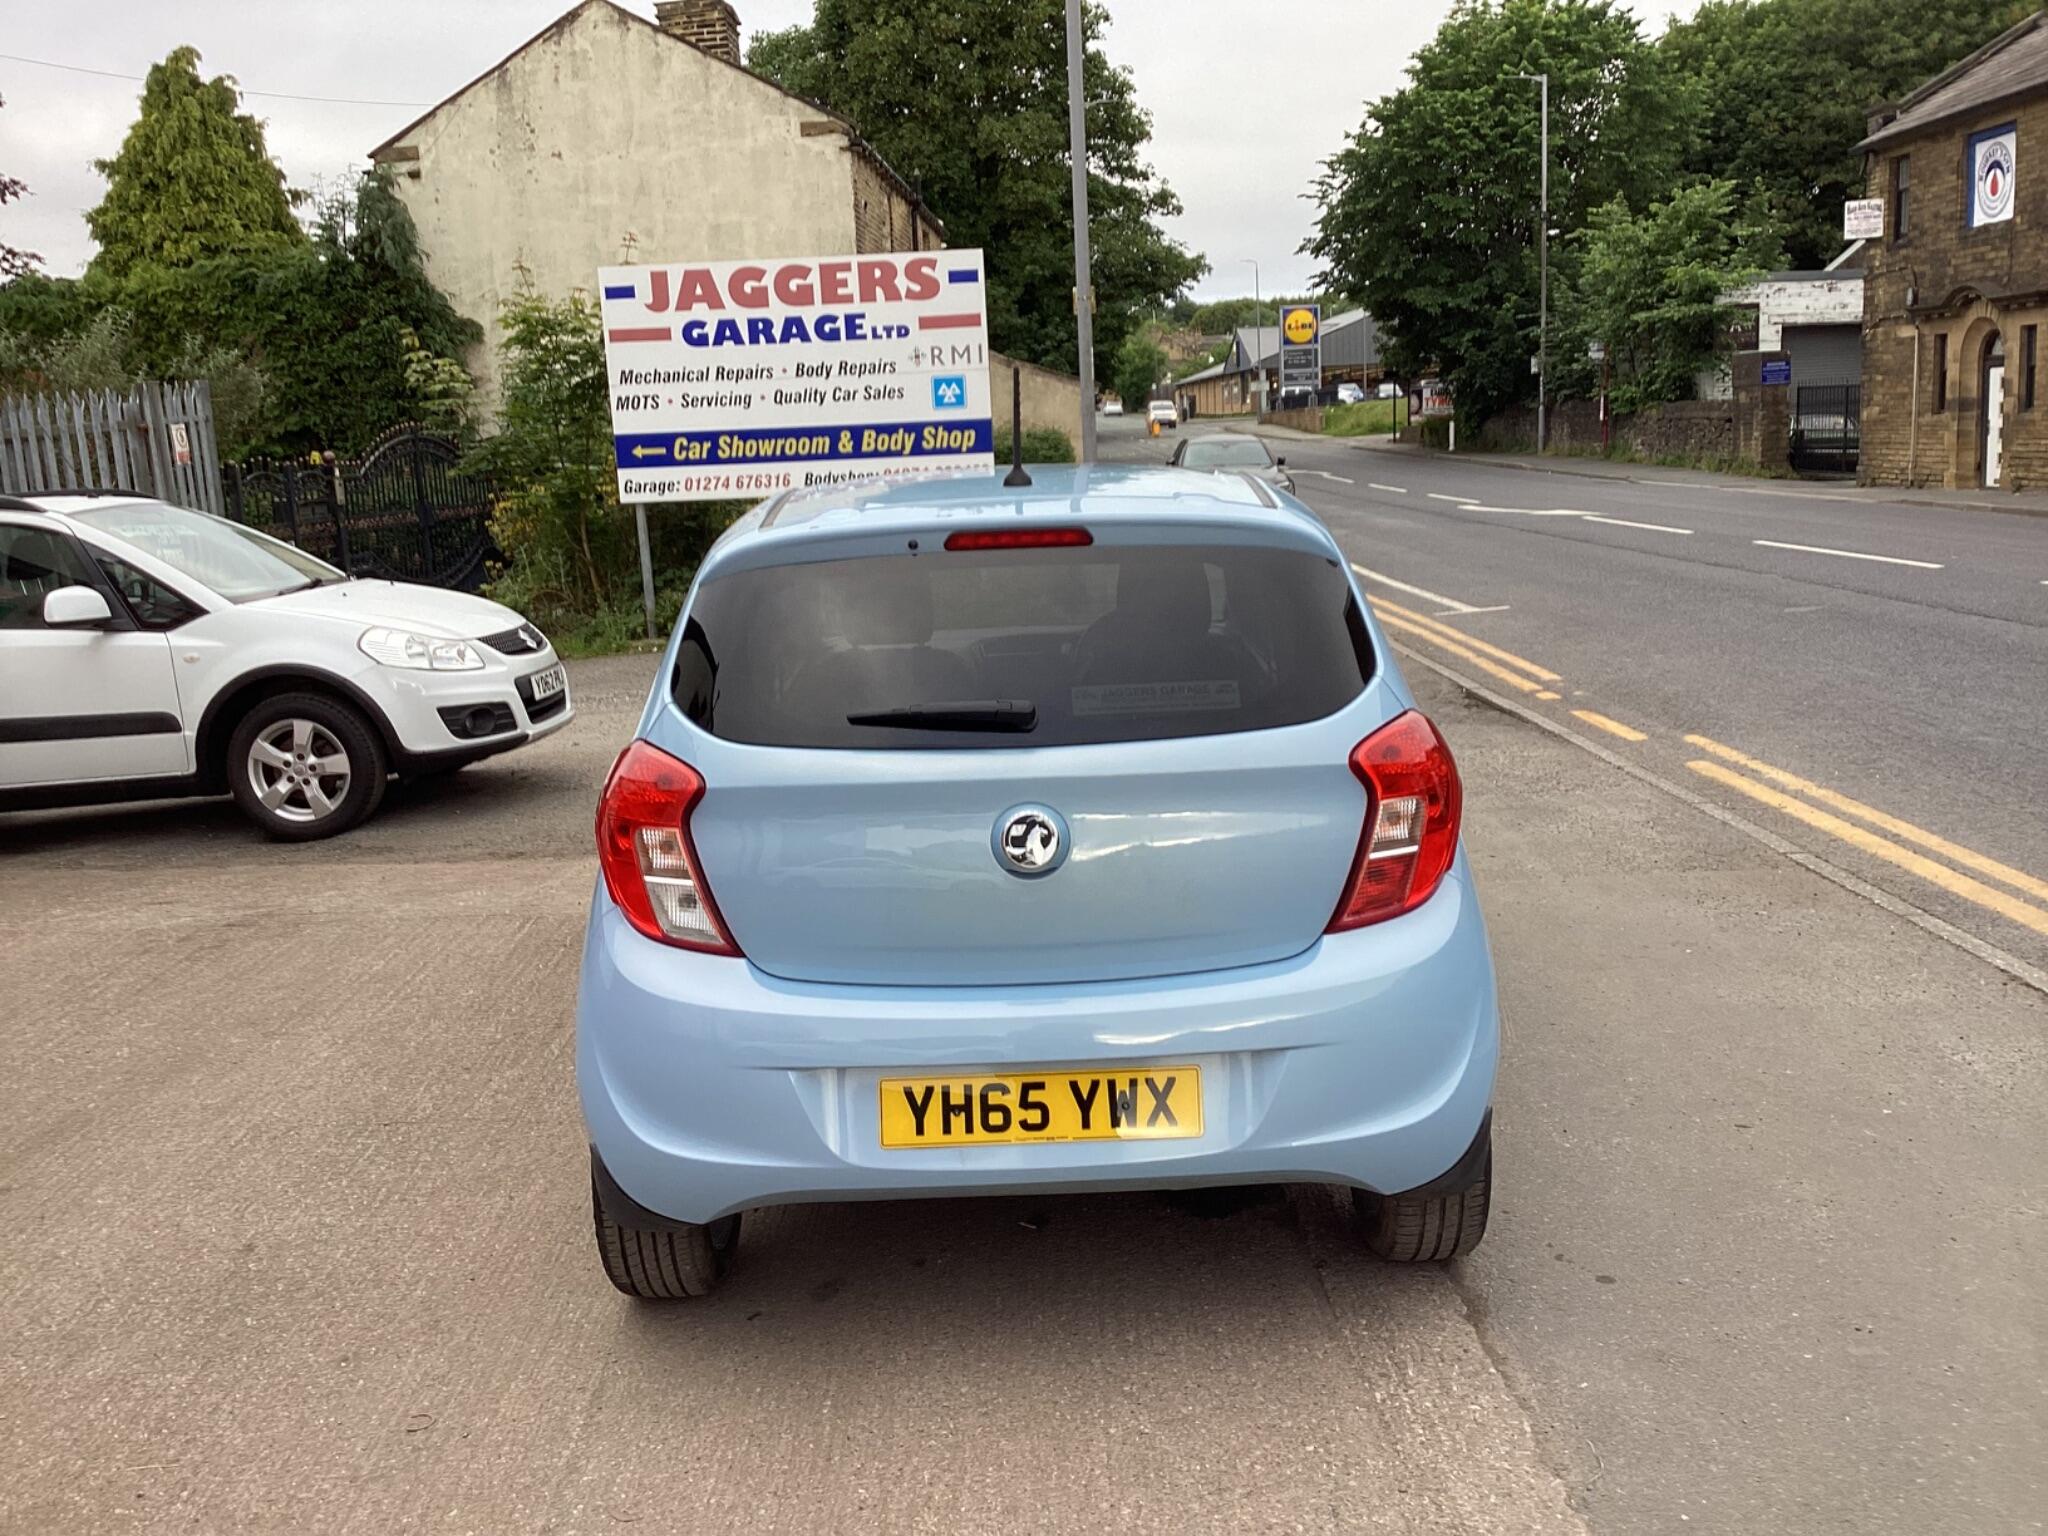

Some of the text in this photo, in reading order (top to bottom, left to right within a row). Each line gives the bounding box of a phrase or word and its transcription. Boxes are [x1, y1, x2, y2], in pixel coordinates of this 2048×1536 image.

[644, 258, 941, 313] JAGGERS
[682, 313, 910, 348] GARAGE LTD
[930, 343, 983, 366] RMI
[619, 358, 897, 386] Mechanical Repairs Body Repairs
[615, 384, 905, 411] MOTS Servicing Quality Car Sales
[673, 425, 976, 461] Car Showroom & Body Shop
[624, 479, 680, 496] Garage:
[684, 475, 730, 492] 01274
[736, 473, 791, 490] 676316
[1102, 686, 1157, 697] JAGGERS
[1160, 684, 1210, 696] GARAGE
[903, 1076, 1178, 1136] YH65 YWX
